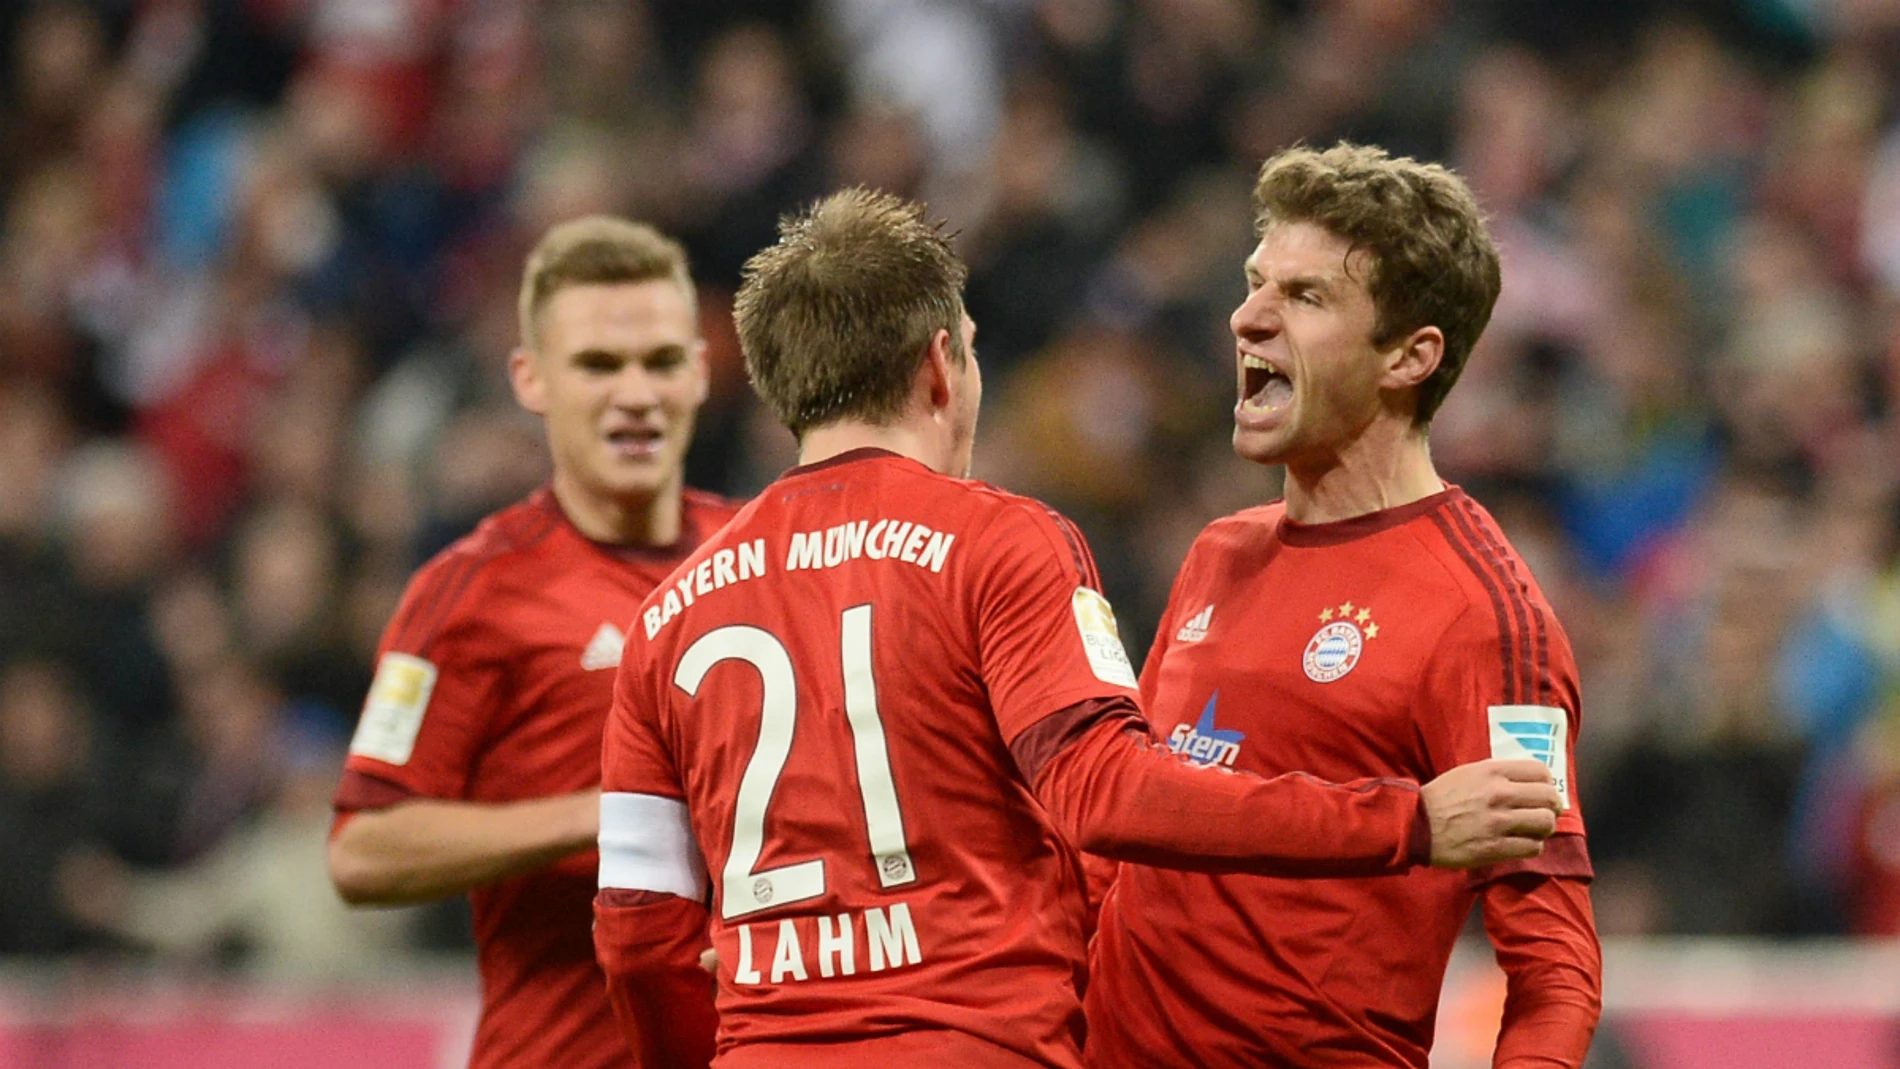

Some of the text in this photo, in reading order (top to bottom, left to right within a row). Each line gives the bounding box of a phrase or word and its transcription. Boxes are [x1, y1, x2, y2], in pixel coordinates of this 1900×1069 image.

[643, 519, 955, 641] BAYERN MÜNCHEN
[673, 603, 916, 920] 21
[1170, 723, 1240, 766] Stern
[734, 902, 922, 985] LAHM
